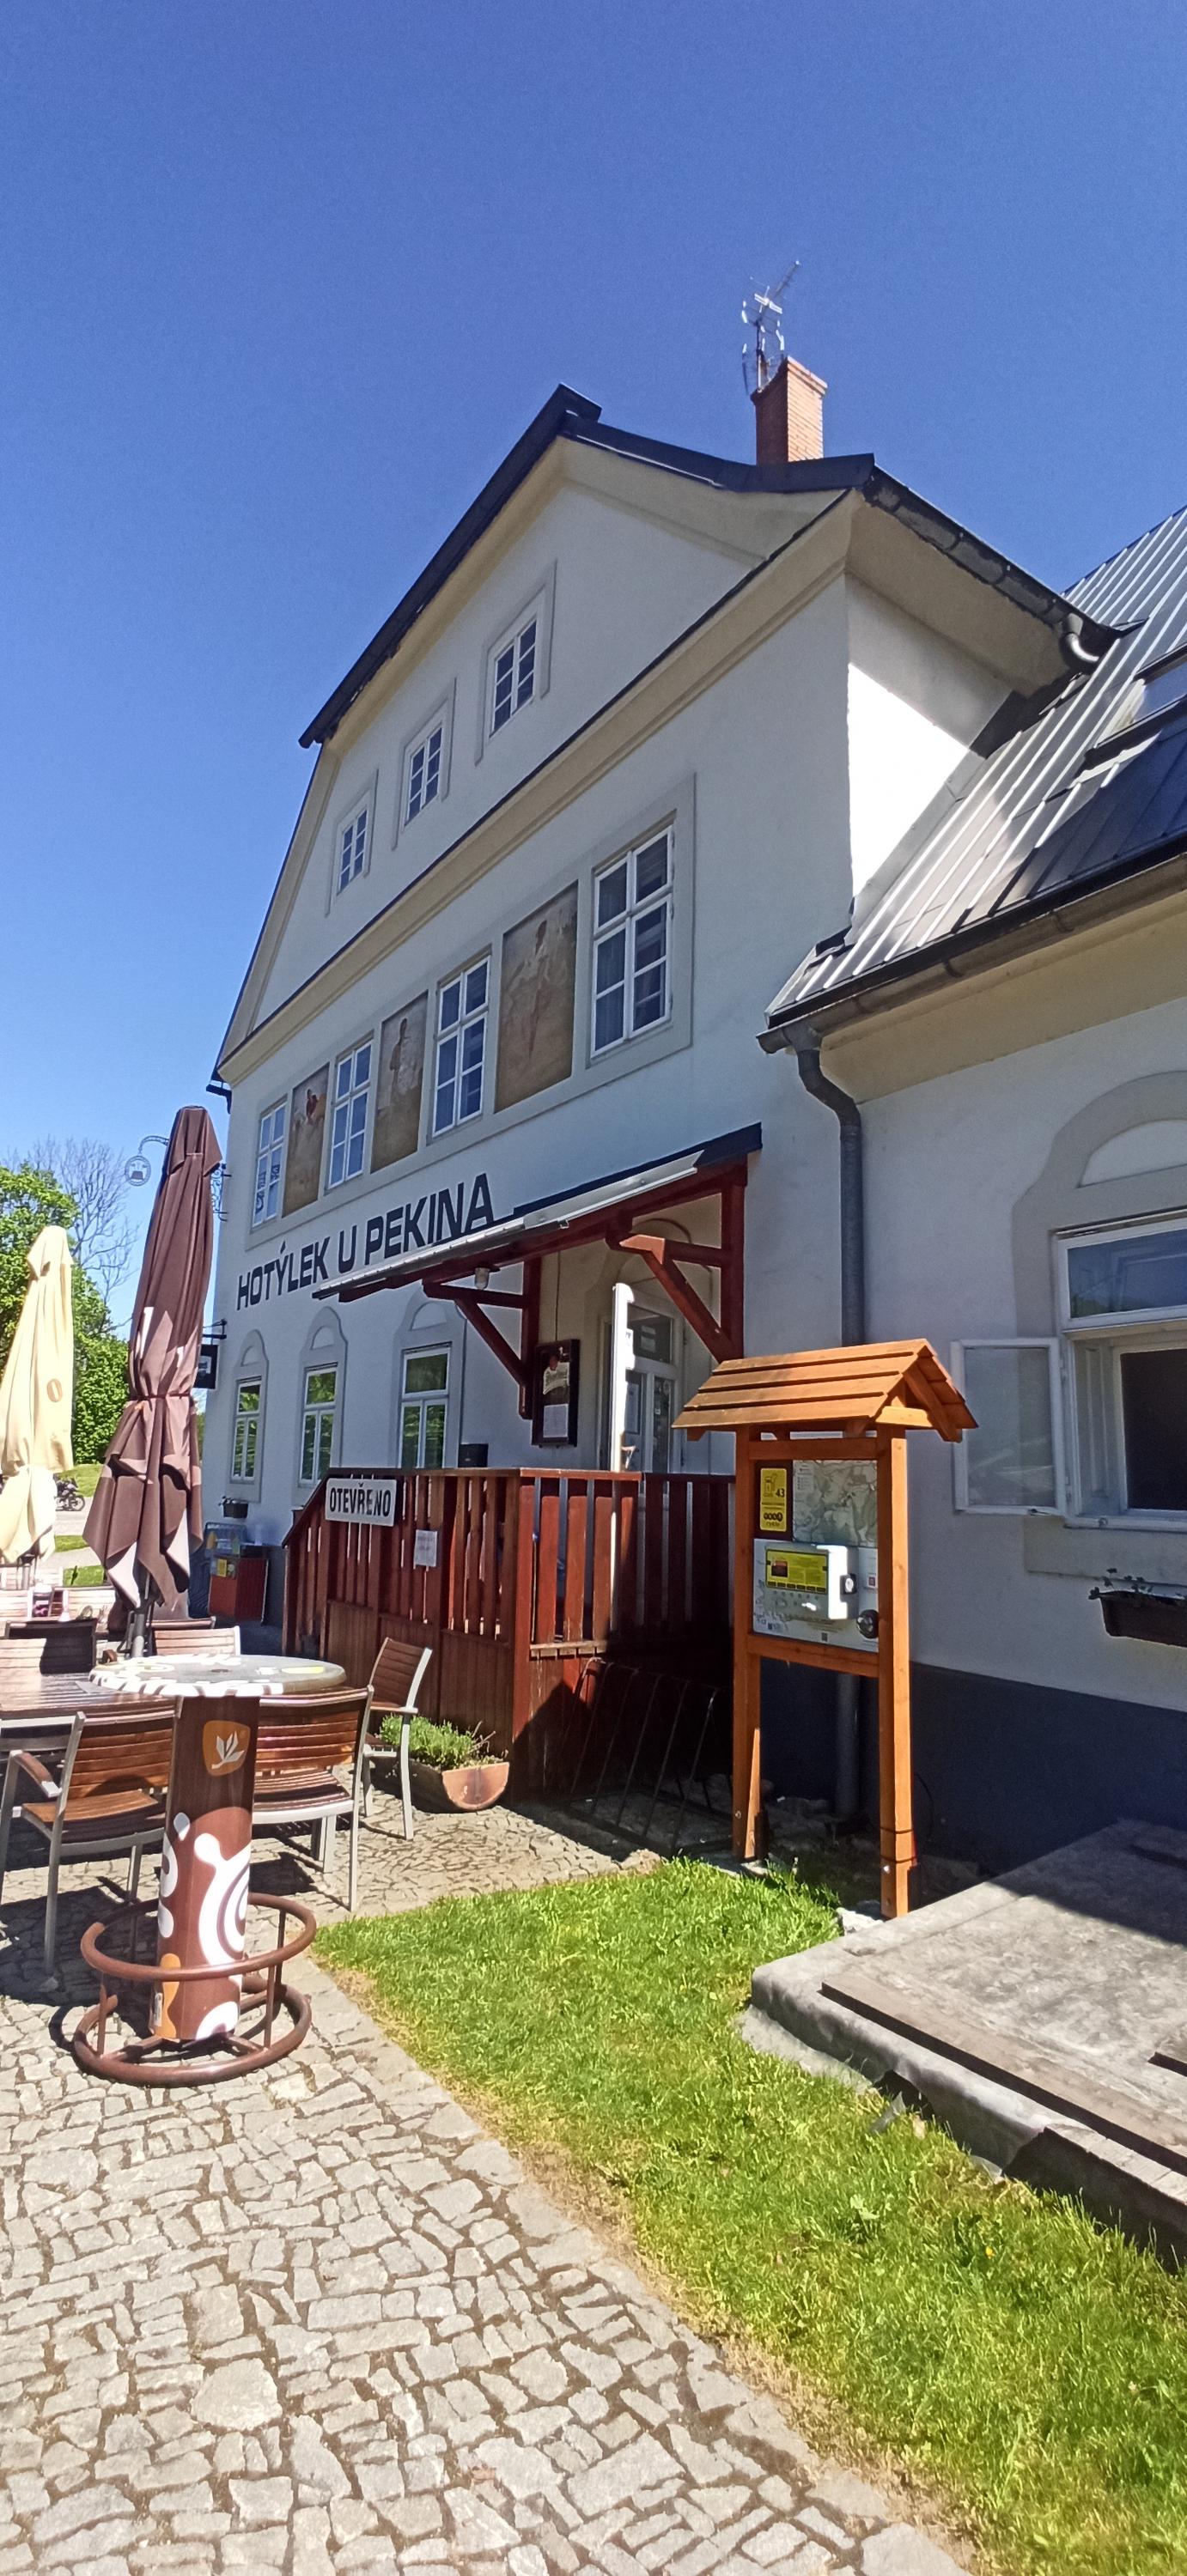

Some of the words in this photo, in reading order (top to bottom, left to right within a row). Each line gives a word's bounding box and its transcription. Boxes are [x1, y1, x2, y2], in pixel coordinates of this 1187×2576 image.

[237, 1236, 330, 1310] HOTÝLEK
[338, 1225, 357, 1274] U
[364, 1173, 495, 1266] PEKINA
[329, 1482, 392, 1517] OTEVŘENO
[775, 1488, 785, 1498] 43
